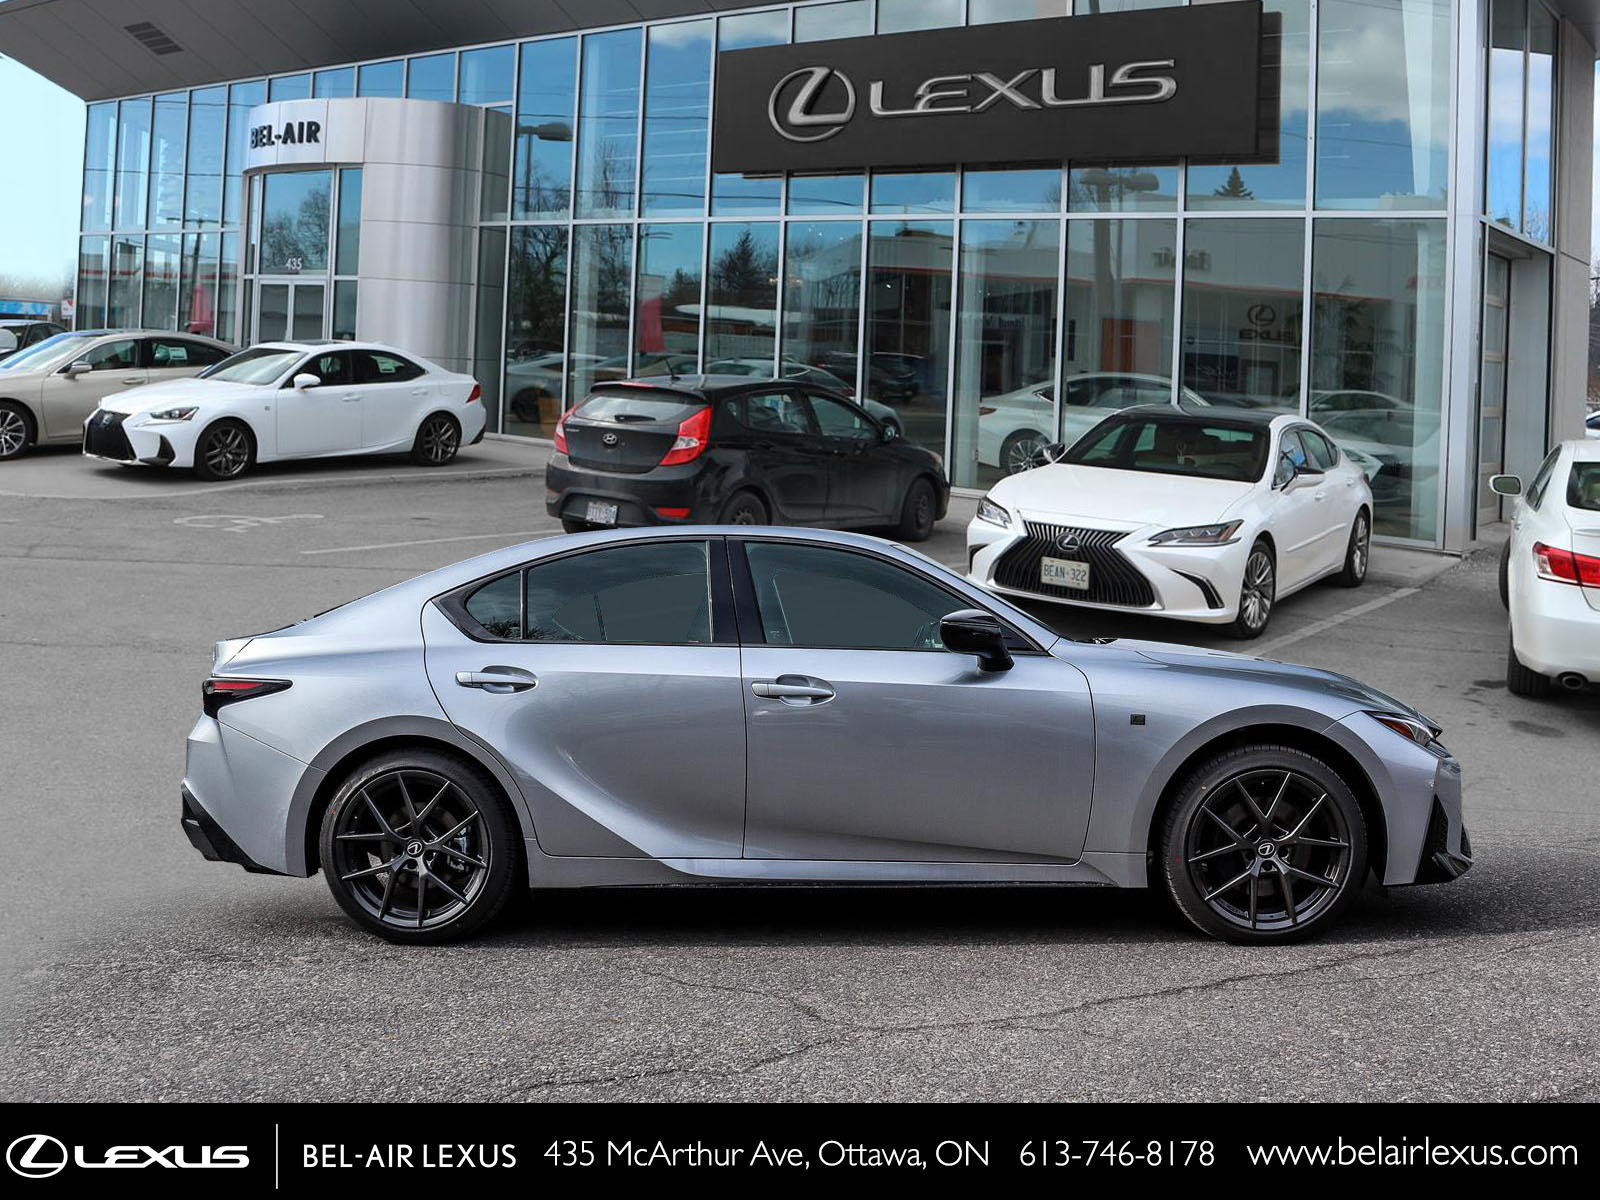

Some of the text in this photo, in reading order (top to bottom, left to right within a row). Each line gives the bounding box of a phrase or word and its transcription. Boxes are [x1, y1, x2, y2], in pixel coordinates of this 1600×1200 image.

[869, 58, 1178, 118] LEXUS
[250, 120, 321, 149] BEL-AIR
[285, 257, 303, 270] 435
[1070, 567, 1087, 583] 322
